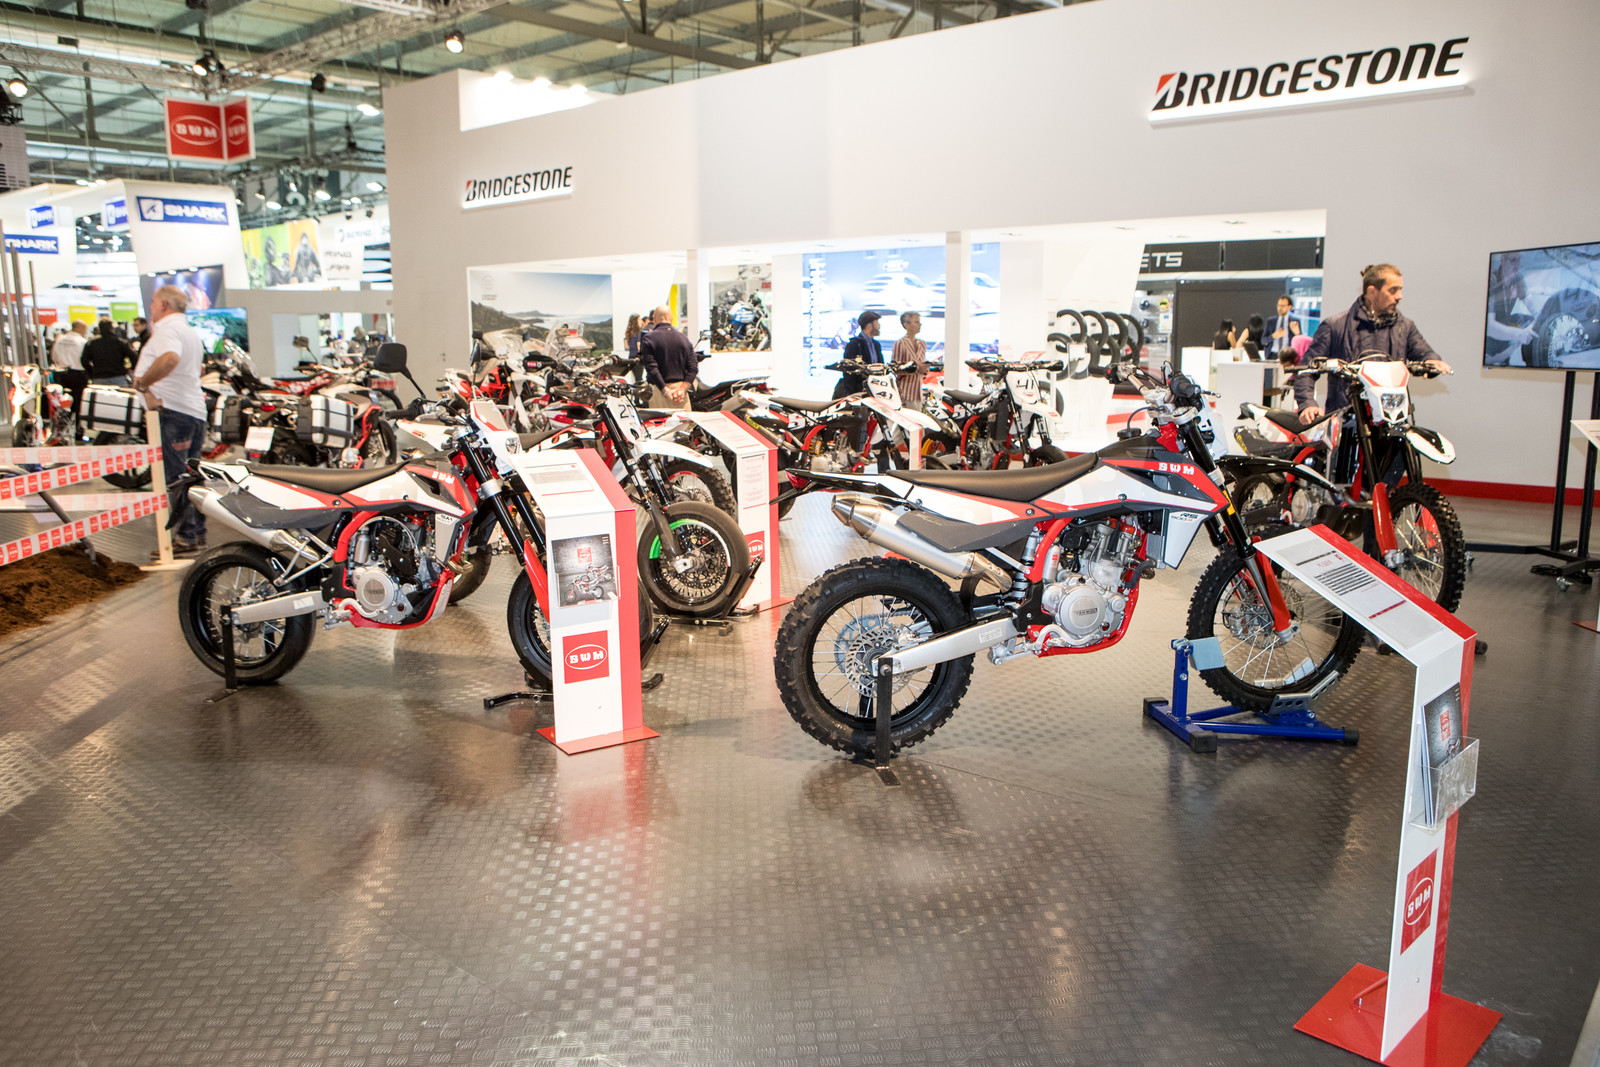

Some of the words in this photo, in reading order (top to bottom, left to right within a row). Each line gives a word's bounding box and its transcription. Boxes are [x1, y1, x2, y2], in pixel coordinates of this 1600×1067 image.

[1152, 37, 1469, 112] BRIDGESTONE
[175, 123, 218, 138] SWM
[465, 166, 573, 202] BRIDGESTONE
[164, 205, 226, 219] SHARK
[1158, 462, 1195, 476] SWM
[569, 650, 604, 664] SWM
[1407, 884, 1431, 918] SWM
